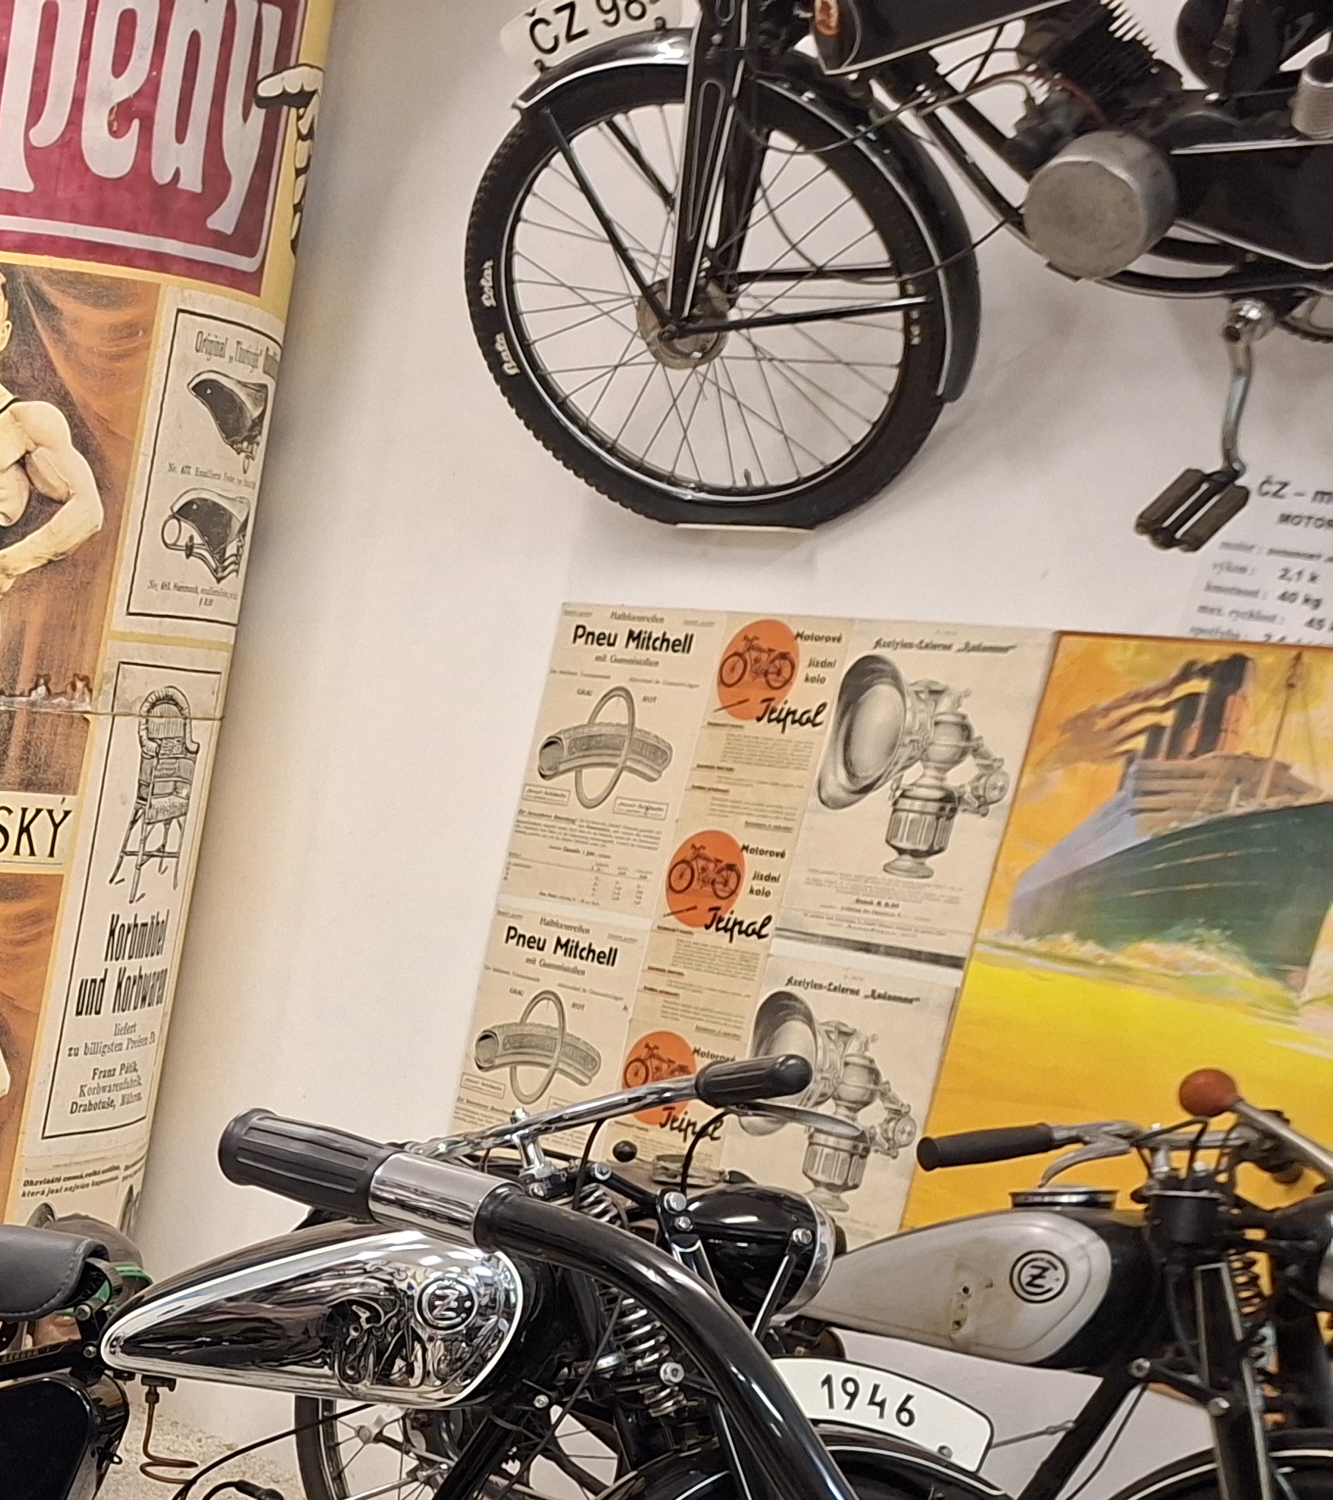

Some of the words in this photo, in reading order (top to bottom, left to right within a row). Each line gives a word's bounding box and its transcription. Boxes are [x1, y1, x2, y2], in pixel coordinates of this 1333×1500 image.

[525, 0, 590, 55] ČZ
[1257, 475, 1291, 500] ČZ
[572, 624, 619, 648] Pneu
[624, 627, 695, 654] Mitchell
[794, 629, 843, 644] Motorové
[803, 672, 827, 686] kolo
[741, 843, 786, 860] Motorové
[748, 885, 772, 898] kolo
[504, 924, 548, 952] Pneu
[552, 934, 619, 968] Mitchell
[74, 967, 109, 1018] und
[67, 1045, 80, 1058] zu
[83, 1039, 124, 1058] billigsten
[819, 1372, 917, 1429] 1946
